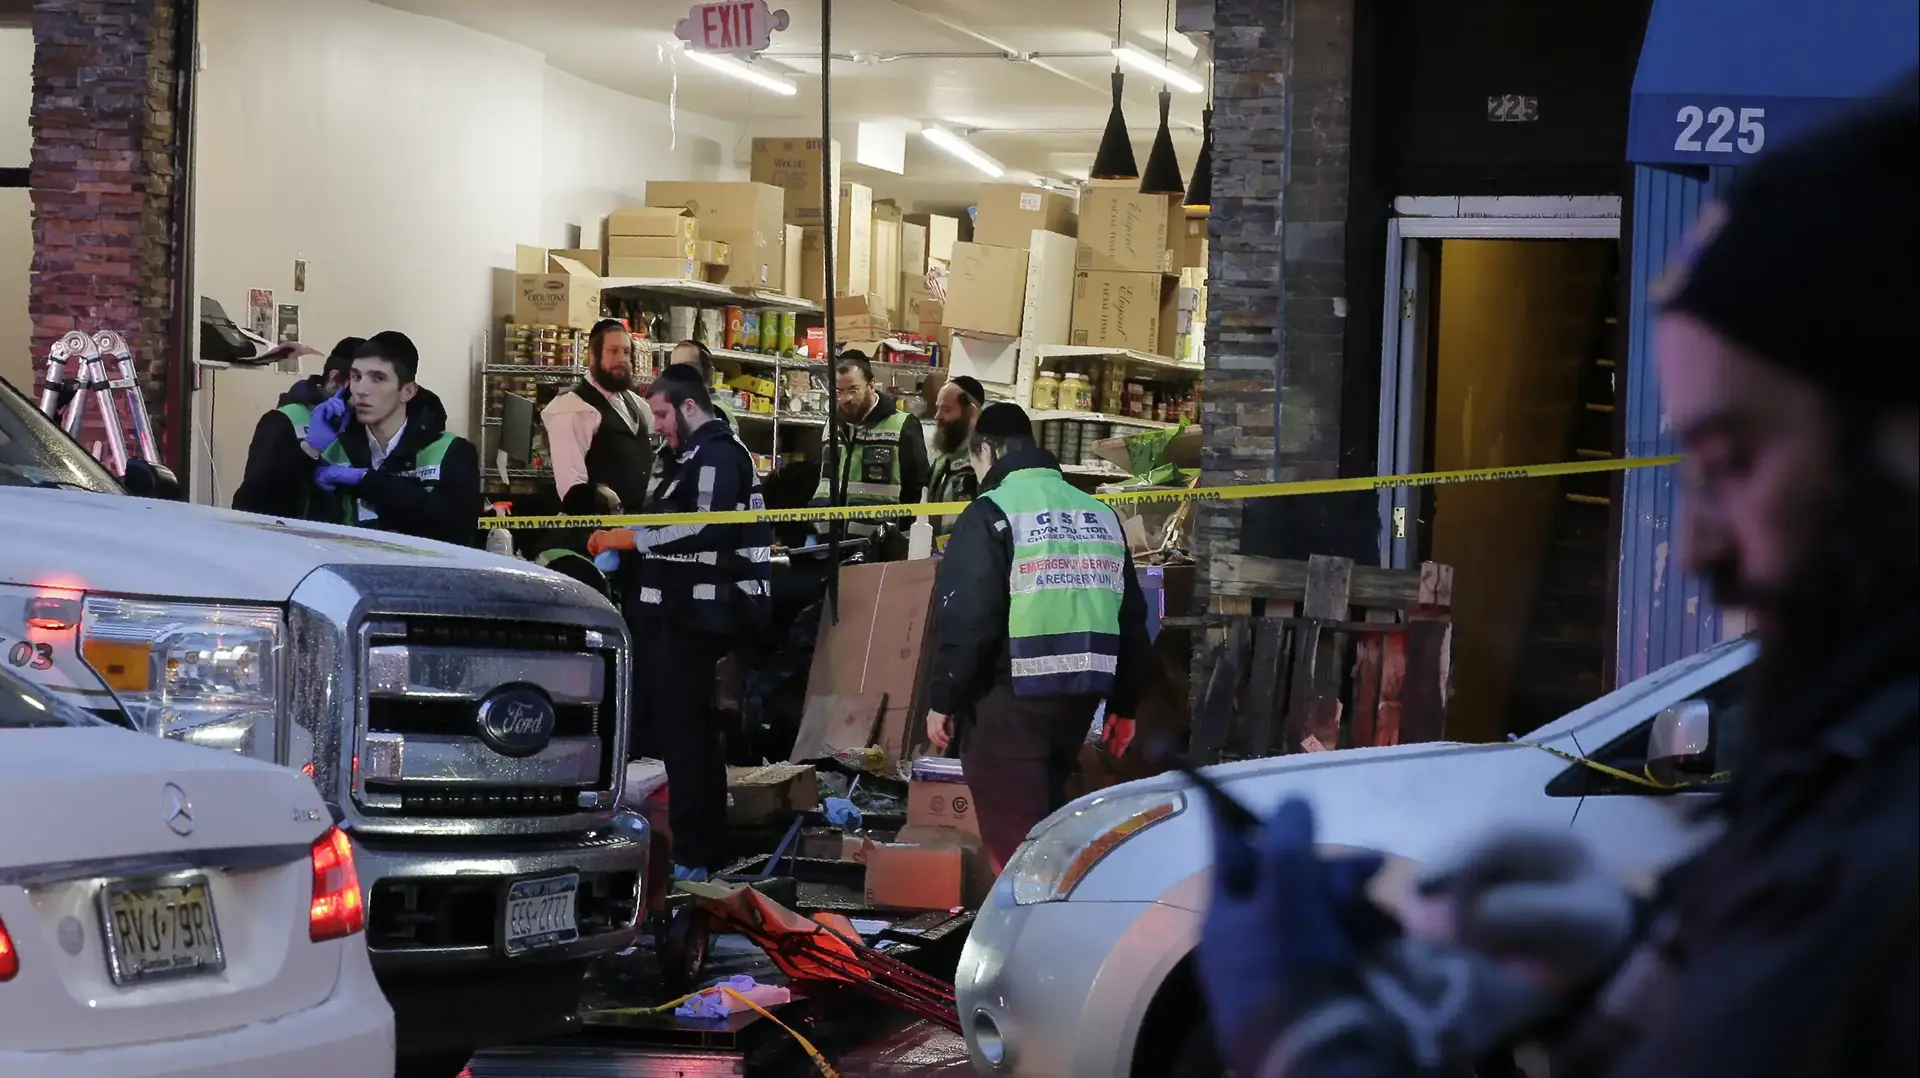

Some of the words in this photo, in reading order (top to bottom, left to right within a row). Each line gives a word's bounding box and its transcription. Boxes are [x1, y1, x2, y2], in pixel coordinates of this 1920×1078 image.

[702, 3, 754, 49] EXIT
[1488, 95, 1538, 121] 225
[1674, 106, 1765, 154] 225
[1122, 202, 1141, 255] Elegant
[1101, 282, 1110, 311] FACIAL
[1112, 285, 1133, 338] Elegant
[1099, 314, 1108, 341] TISSUE
[1080, 526, 1108, 534] חסד
[1036, 575, 1044, 585] &
[1046, 574, 1096, 585] RECOERY
[1082, 559, 1119, 573] SERVIES
[8, 641, 53, 670] 03
[503, 701, 543, 734] Ford
